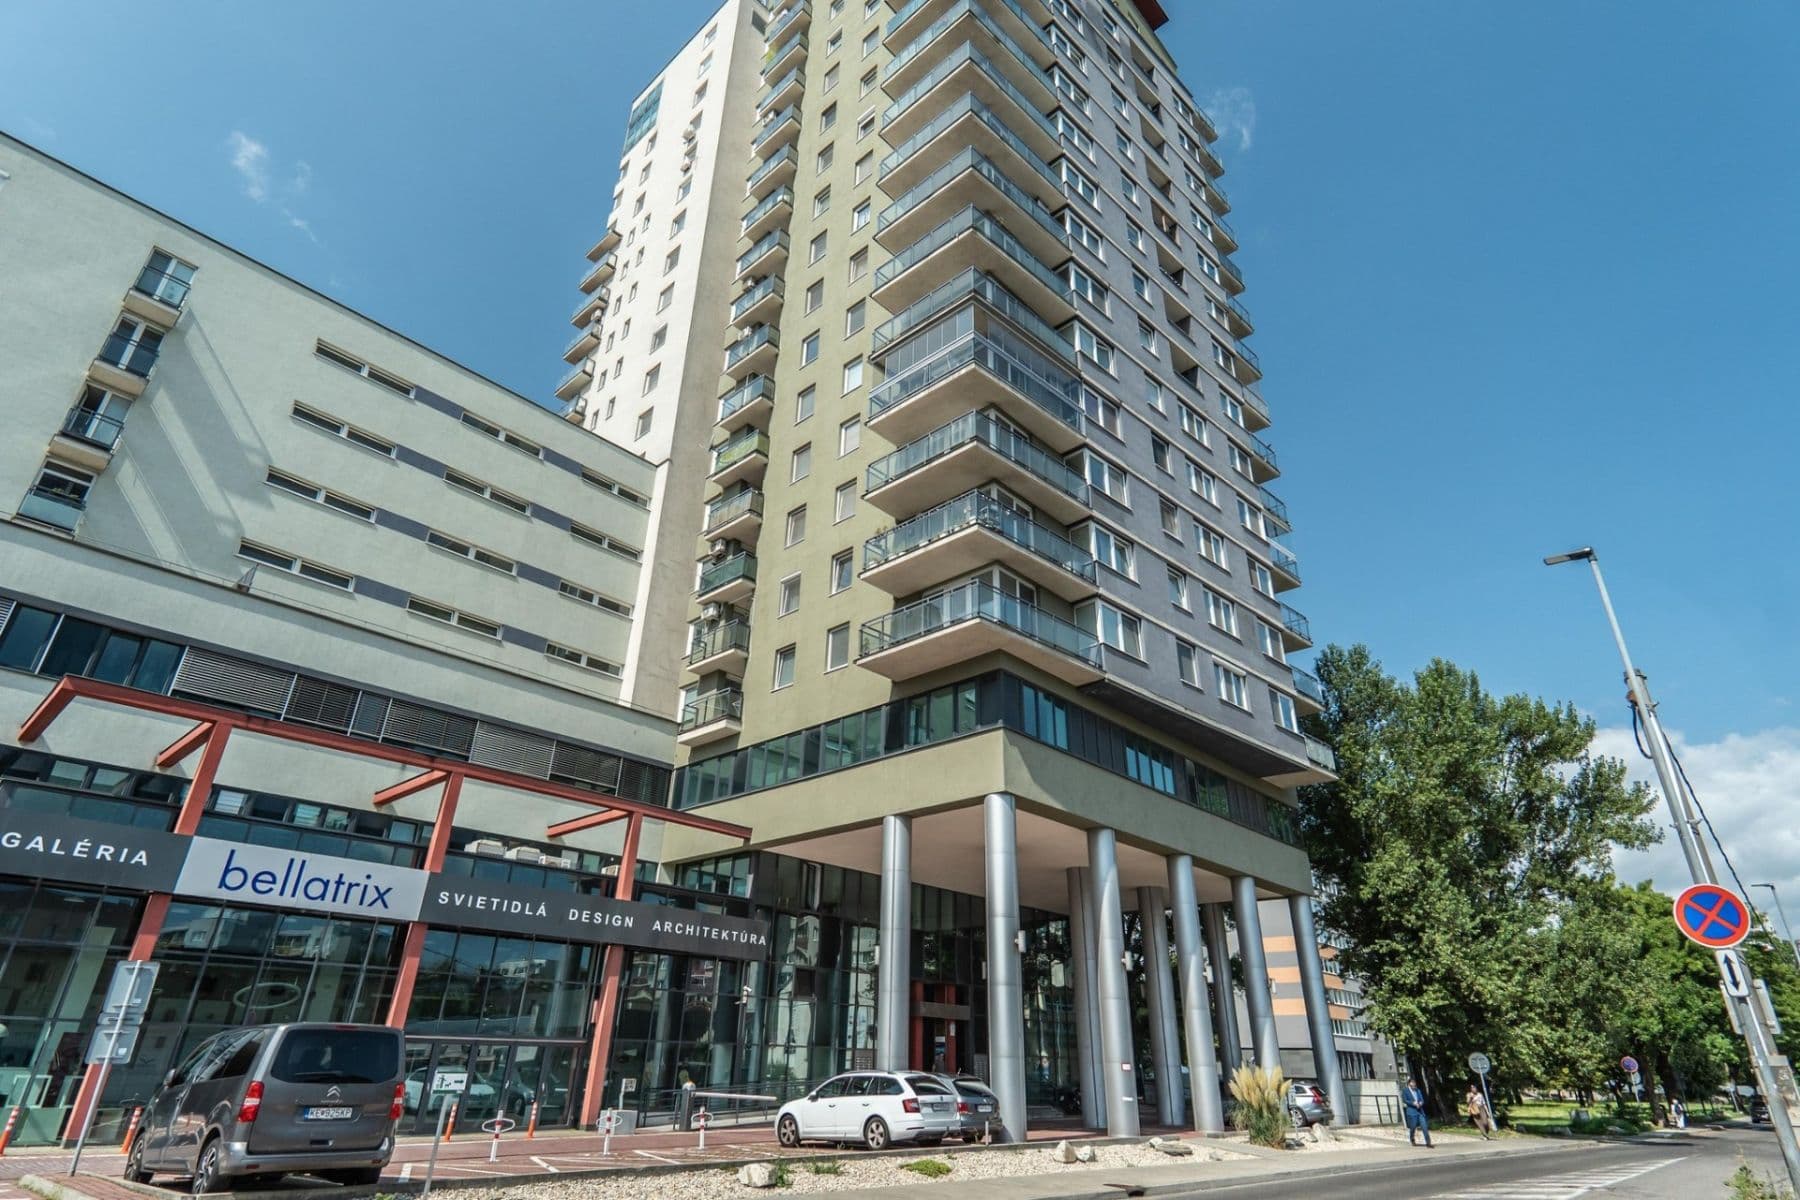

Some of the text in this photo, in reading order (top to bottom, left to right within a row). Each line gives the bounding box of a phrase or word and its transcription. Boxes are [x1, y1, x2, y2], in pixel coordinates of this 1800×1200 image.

[1, 831, 149, 866] GALÉRIA
[217, 849, 394, 910] bellatrix
[438, 891, 767, 947] SVIETIDLÁ DESIGN ARCHITEKTÚRA
